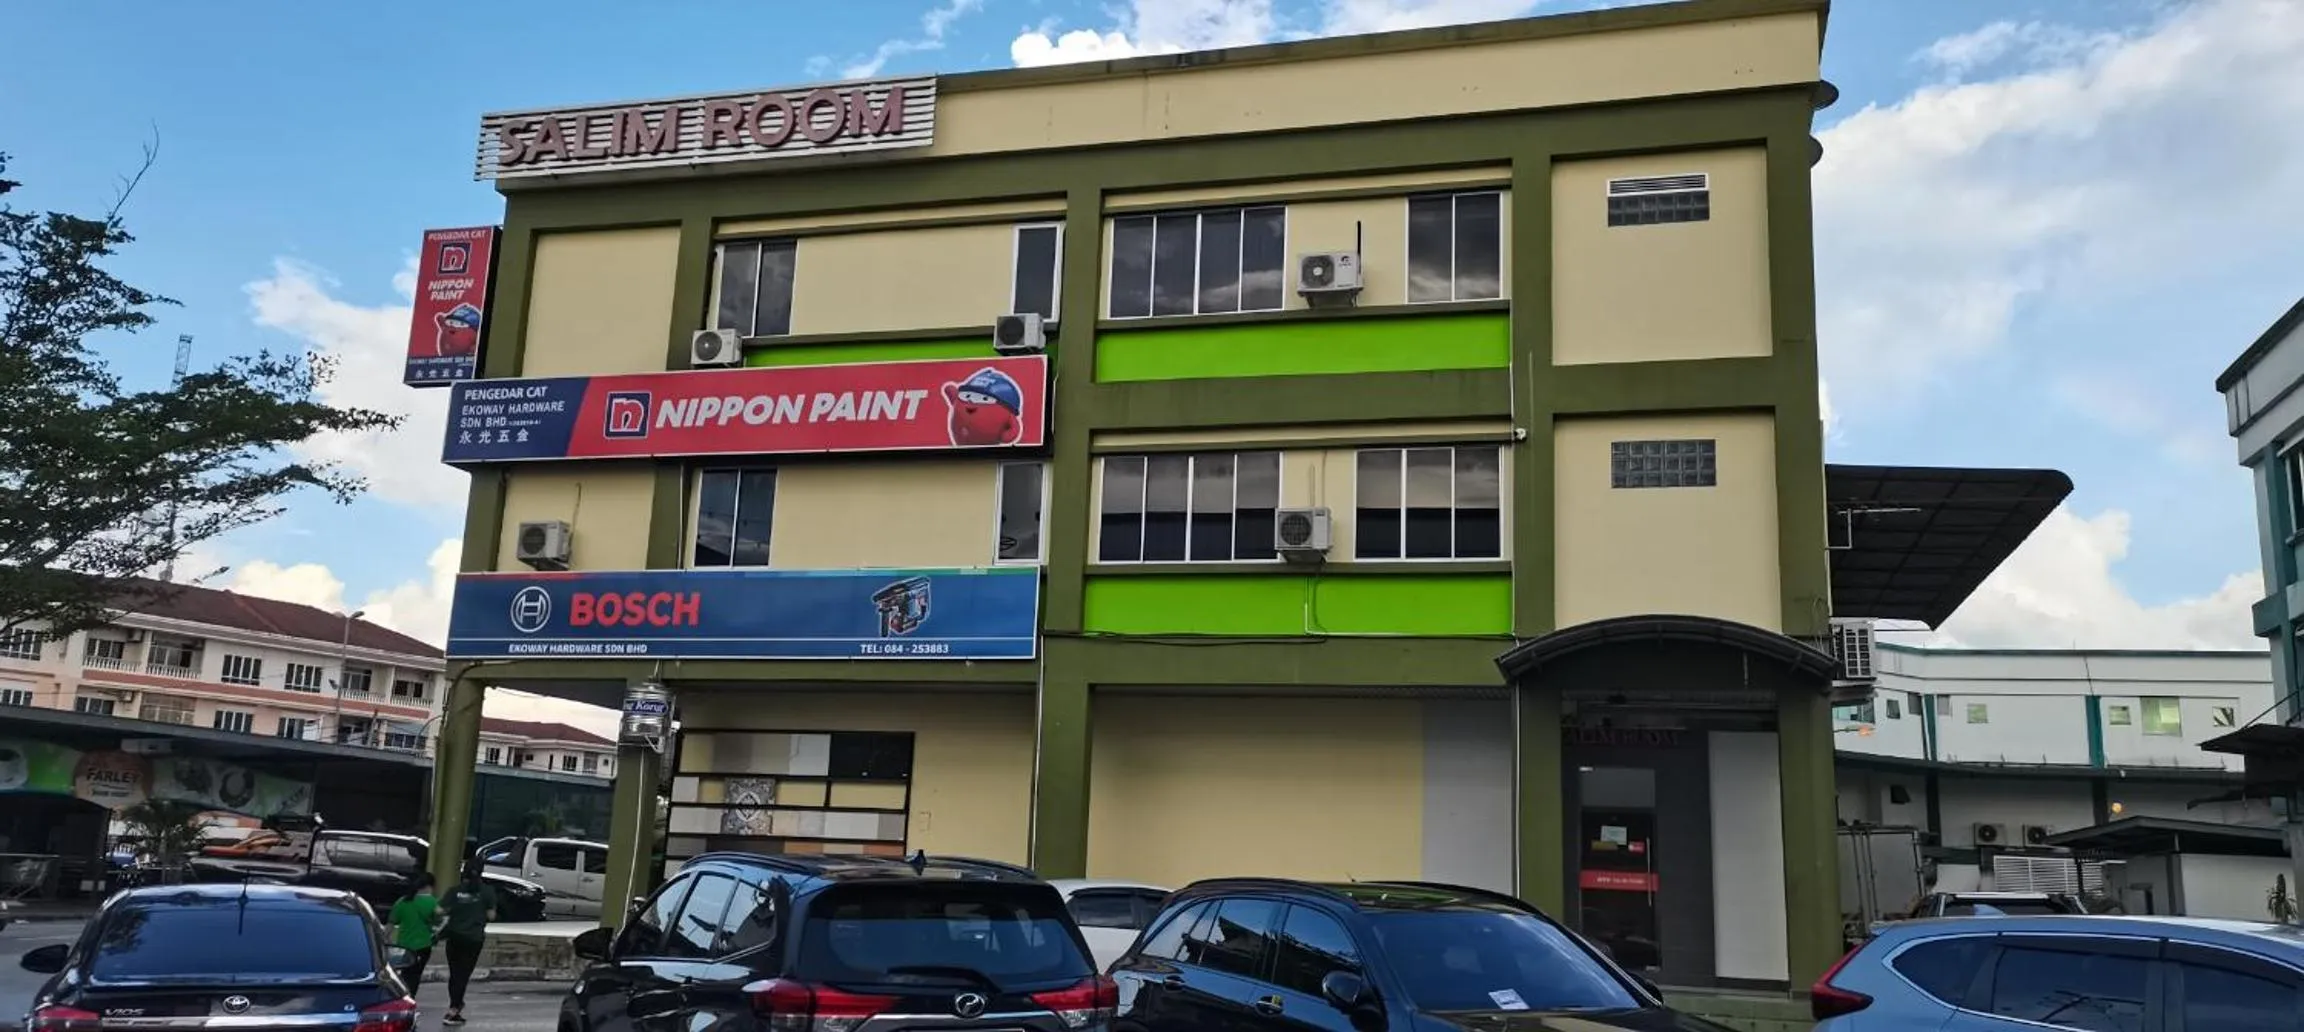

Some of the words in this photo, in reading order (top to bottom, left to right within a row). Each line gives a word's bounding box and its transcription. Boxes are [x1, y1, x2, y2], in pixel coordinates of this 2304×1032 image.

[500, 106, 681, 166] SALIM
[702, 86, 906, 148] ROOM
[471, 229, 487, 239] CAT
[428, 278, 474, 291] NIPPON
[430, 289, 465, 301] PAINT
[464, 386, 524, 401] PENGEDAR
[526, 385, 548, 398] CAT
[461, 404, 505, 416] EKOWAY
[507, 400, 566, 414] HARDWARE
[654, 392, 804, 429] NIPPON
[808, 389, 928, 423] PAINT
[460, 416, 482, 429] SDN
[485, 416, 507, 428] BHD
[459, 428, 529, 444] 永光五金
[569, 591, 701, 627] BOSCH
[508, 644, 548, 654] EKOWAY
[549, 644, 603, 654] HARDWARE
[604, 644, 625, 654] SDN
[626, 644, 648, 654] BHD
[860, 644, 883, 654] TEL:
[884, 644, 903, 654] 084
[86, 767, 139, 784] FARLEY
[105, 1008, 145, 1017] VIOS
